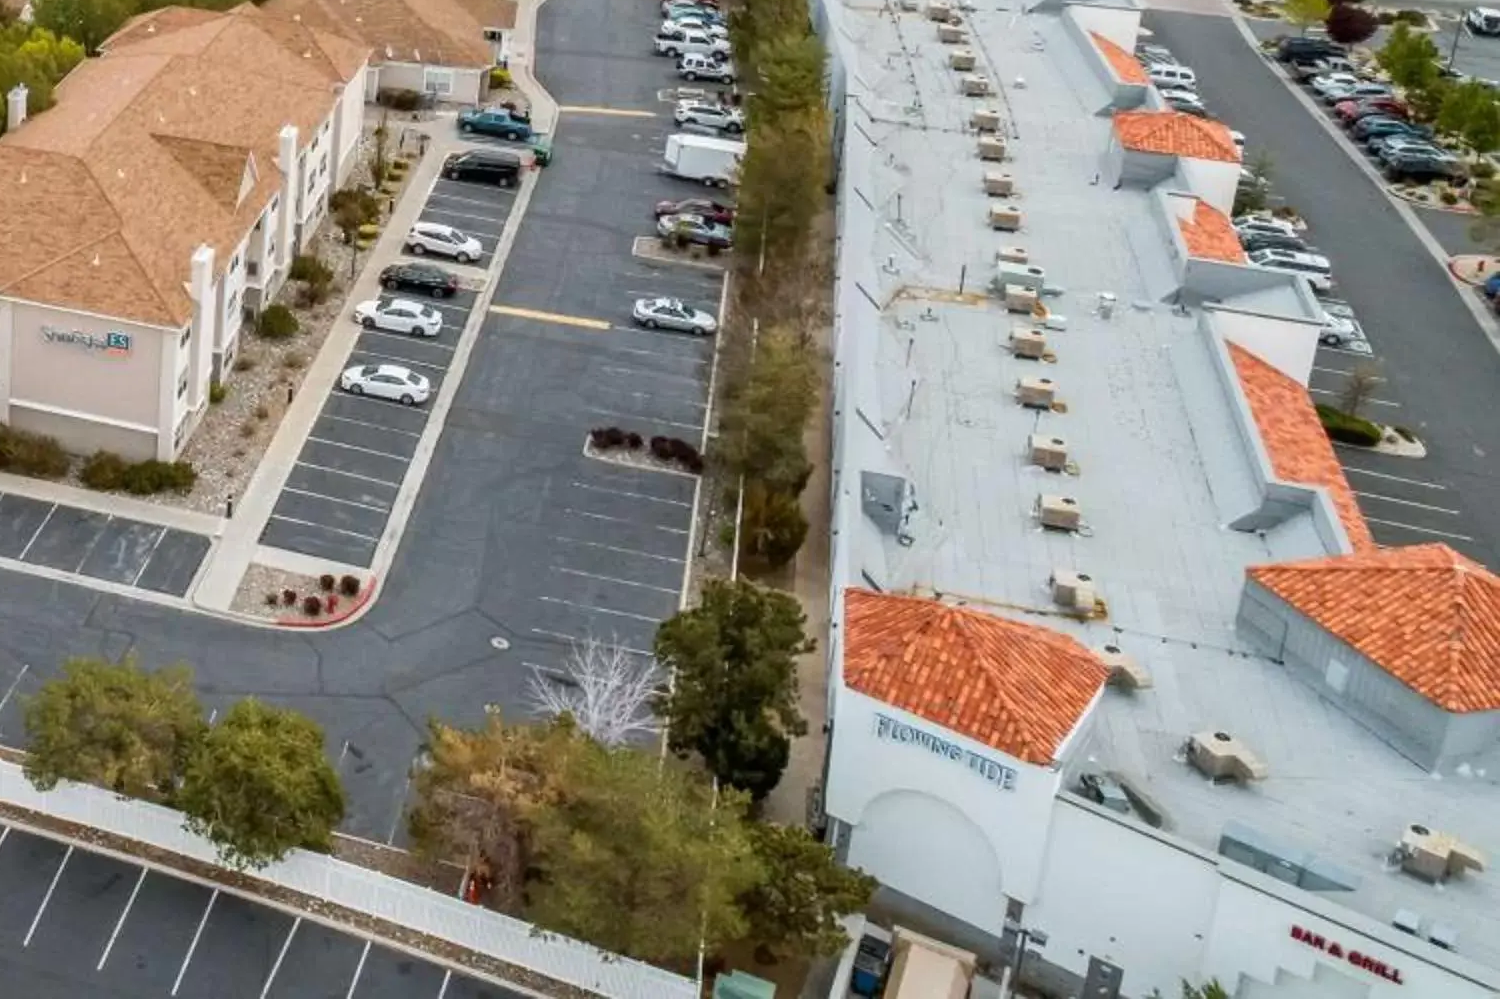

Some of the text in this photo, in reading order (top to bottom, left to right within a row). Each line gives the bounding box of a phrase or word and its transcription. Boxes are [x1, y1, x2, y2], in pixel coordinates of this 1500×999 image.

[876, 712, 1017, 791] FLOWING TIDE
[1291, 925, 1325, 950] BAR
[1348, 951, 1403, 984] GRILL
